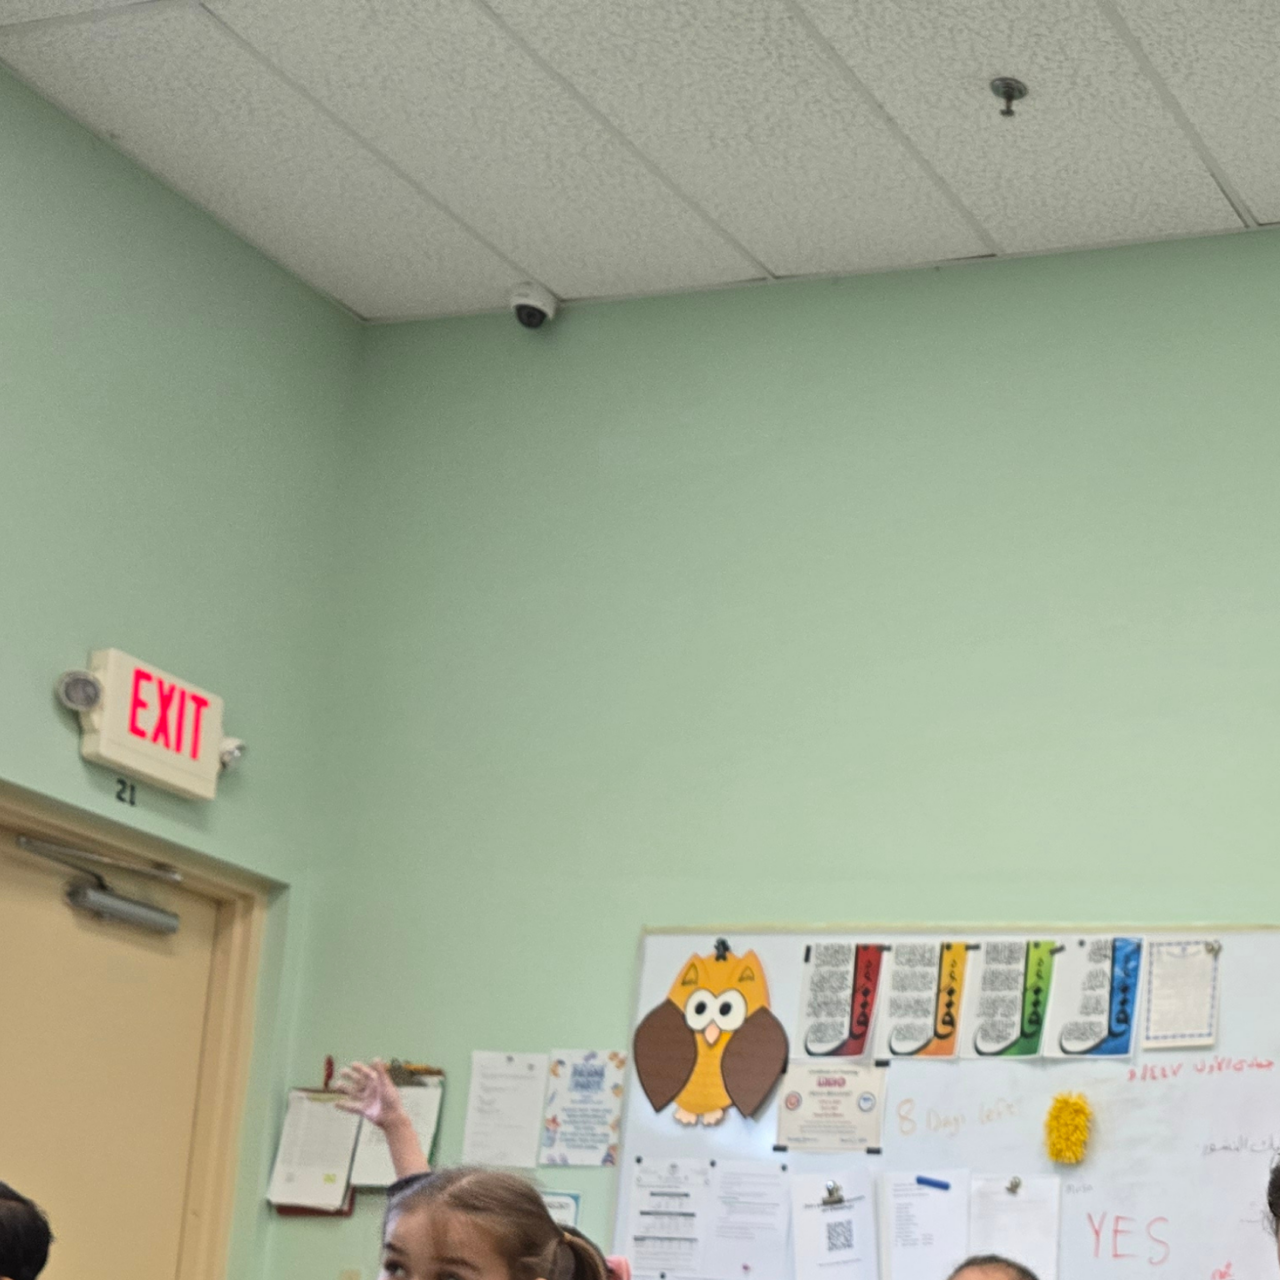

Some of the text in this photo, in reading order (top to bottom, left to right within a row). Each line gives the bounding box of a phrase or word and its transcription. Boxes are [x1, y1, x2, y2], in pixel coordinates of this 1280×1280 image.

[128, 667, 210, 760] EXIT
[116, 778, 136, 806] 21
[1087, 1211, 1171, 1266] YES
